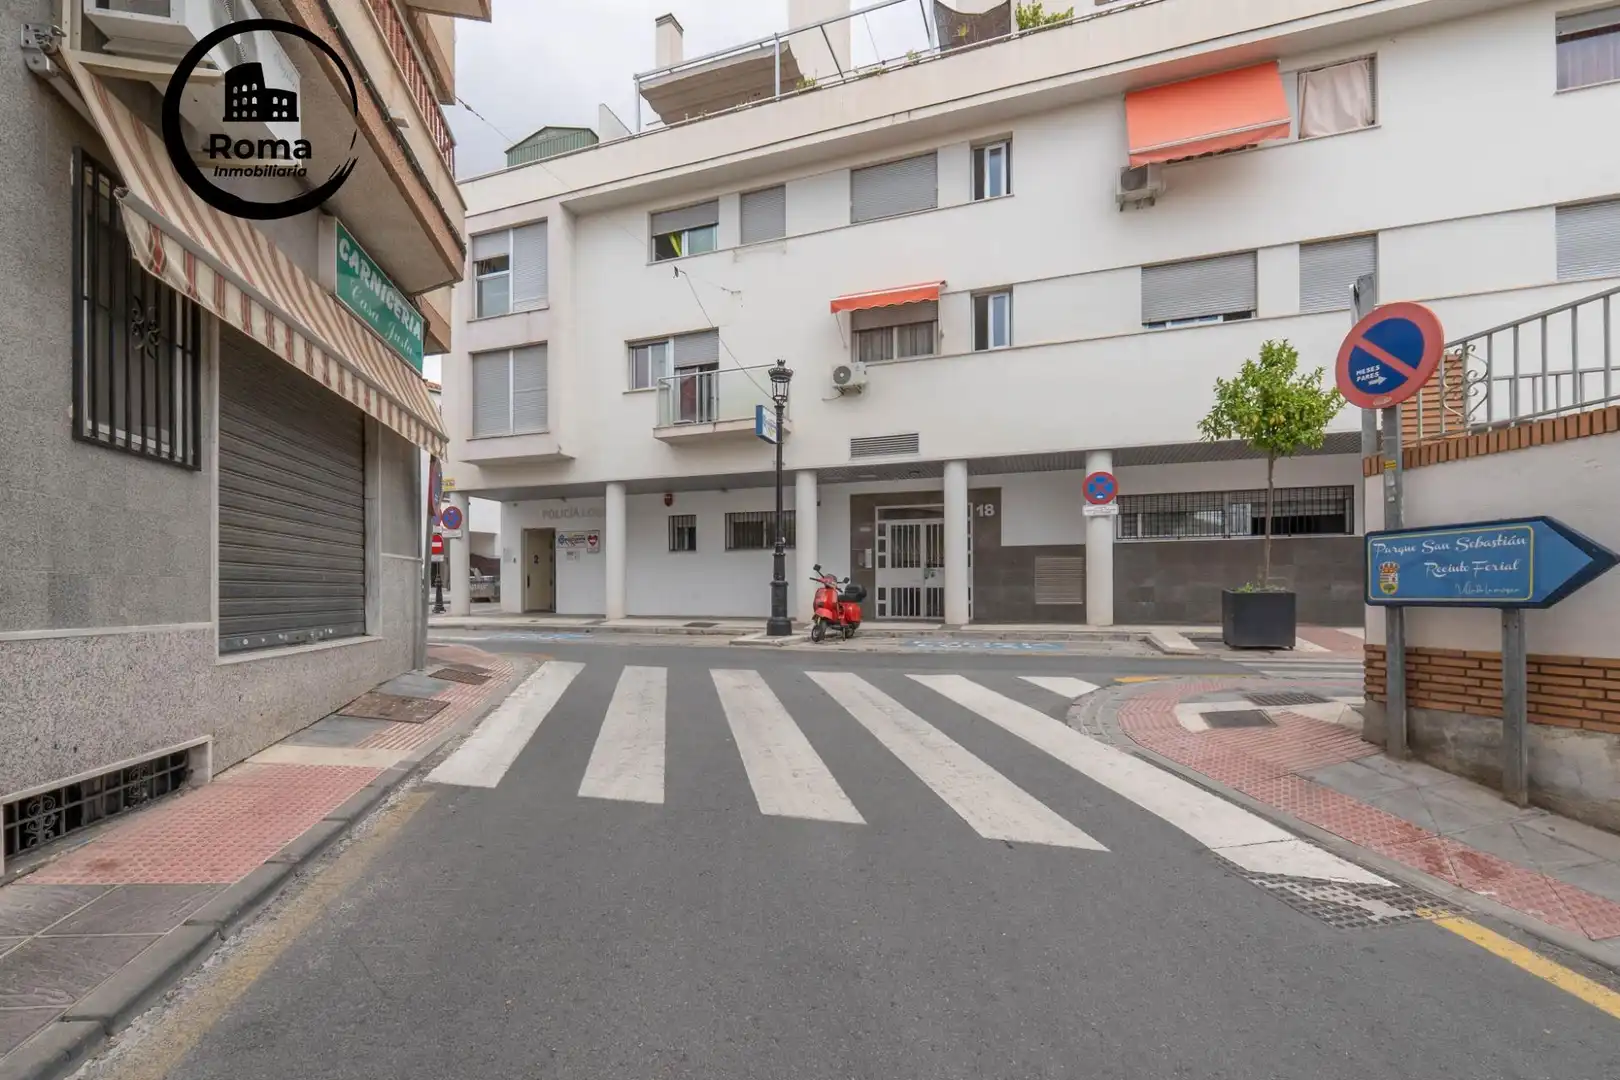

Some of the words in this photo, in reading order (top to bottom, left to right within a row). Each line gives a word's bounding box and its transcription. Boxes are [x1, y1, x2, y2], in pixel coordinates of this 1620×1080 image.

[339, 238, 422, 341] CARNICERIA
[1356, 365, 1380, 375] MESES
[1356, 371, 1379, 381] PARES
[976, 503, 995, 517] 18
[1373, 542, 1416, 560] Parque
[1422, 539, 1450, 555] San
[1455, 533, 1527, 552] Sebastián
[1424, 561, 1469, 579] Recinto
[1472, 559, 1520, 577] Ferial
